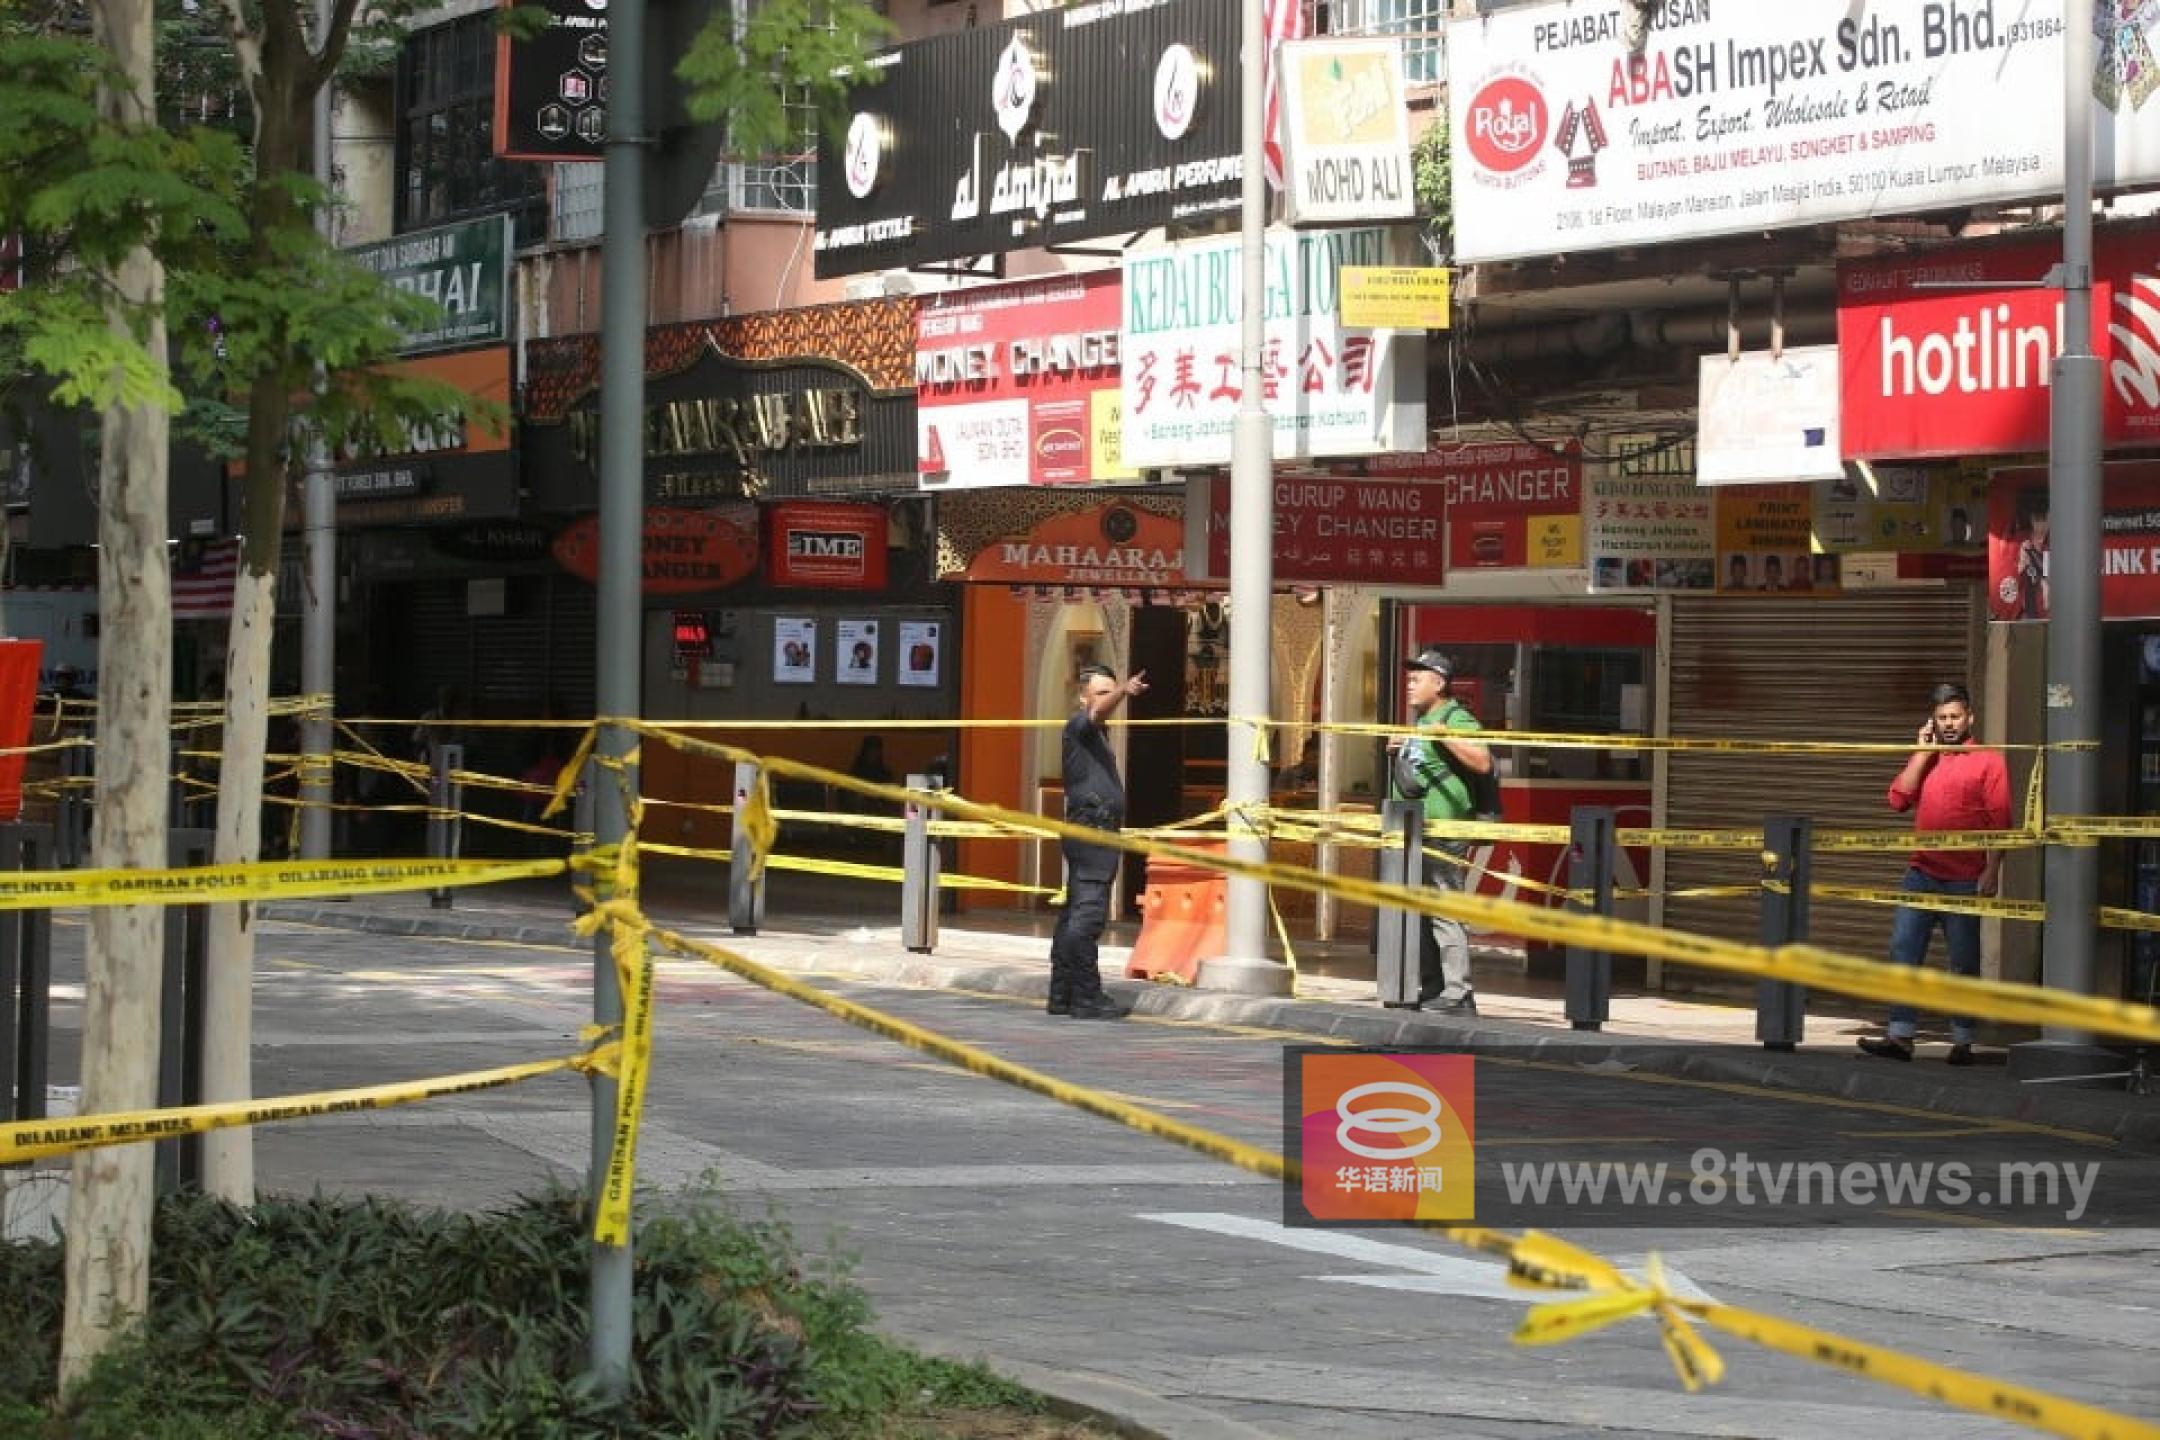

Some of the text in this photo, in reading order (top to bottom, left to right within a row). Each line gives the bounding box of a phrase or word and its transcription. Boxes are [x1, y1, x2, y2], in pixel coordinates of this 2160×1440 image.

[1534, 0, 1711, 51] PEJABAT USAN
[1608, 41, 1717, 108] ABASH
[1727, 26, 1829, 99] Impex
[1837, 13, 1911, 73] Sdn.
[1923, 0, 2005, 58] Bhd.
[1763, 89, 1849, 129] Wholesale
[1855, 81, 1868, 114] &
[1693, 152, 1727, 174] BAJU
[1790, 134, 1855, 160] SONGKET
[1871, 122, 1936, 149] SAMPING
[1306, 154, 1402, 203] MOHD ALI
[1130, 254, 1202, 334] KEDAI
[916, 329, 1122, 383] MONEY CHANGE
[1880, 303, 2065, 397] hotlin
[1274, 483, 1421, 513] GURUP WANG
[1445, 467, 1569, 505] CHANGER
[1317, 514, 1438, 541] CHANGER
[109, 877, 190, 892] GARISAN
[195, 873, 247, 889] POLIS
[15, 1124, 105, 1147] DILARANG
[608, 1124, 630, 1201] GARISAN
